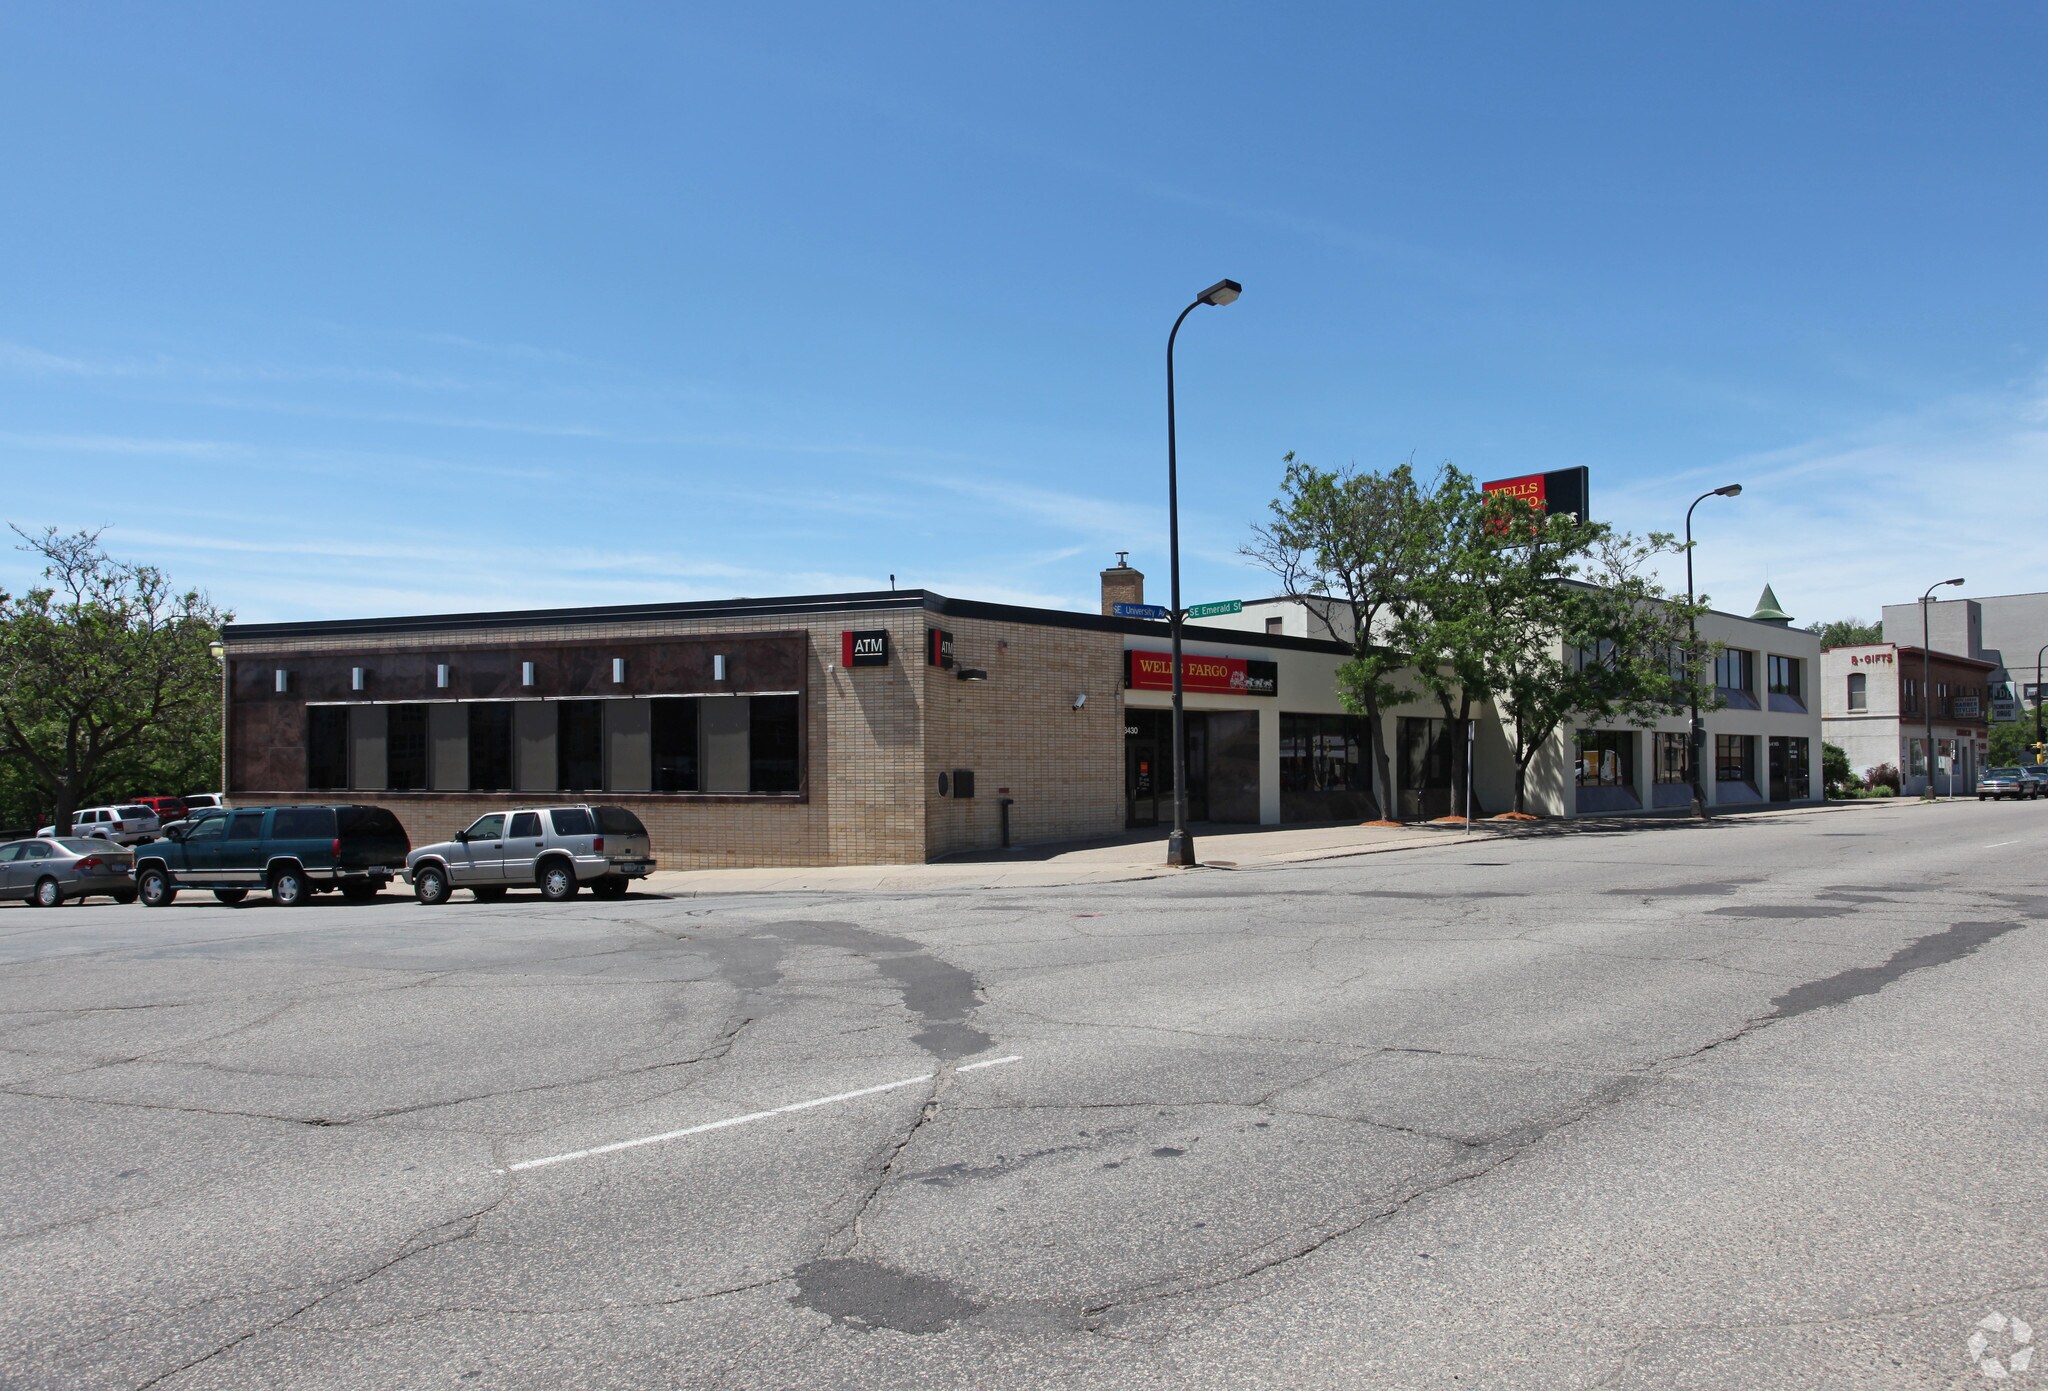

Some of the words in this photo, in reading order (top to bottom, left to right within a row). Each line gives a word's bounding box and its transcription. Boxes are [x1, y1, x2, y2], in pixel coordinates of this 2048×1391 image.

[1484, 482, 1538, 498] WELLS
[1113, 605, 1122, 614] SE
[1125, 606, 1156, 617] University
[1189, 607, 1199, 617] SE
[1202, 603, 1231, 615] Emerald
[1233, 602, 1242, 611] St
[855, 638, 883, 653] ATM
[941, 640, 953, 654] ATM
[1140, 659, 1184, 674] WELL
[1188, 663, 1228, 678] FARGO
[1124, 726, 1139, 734] 3430
